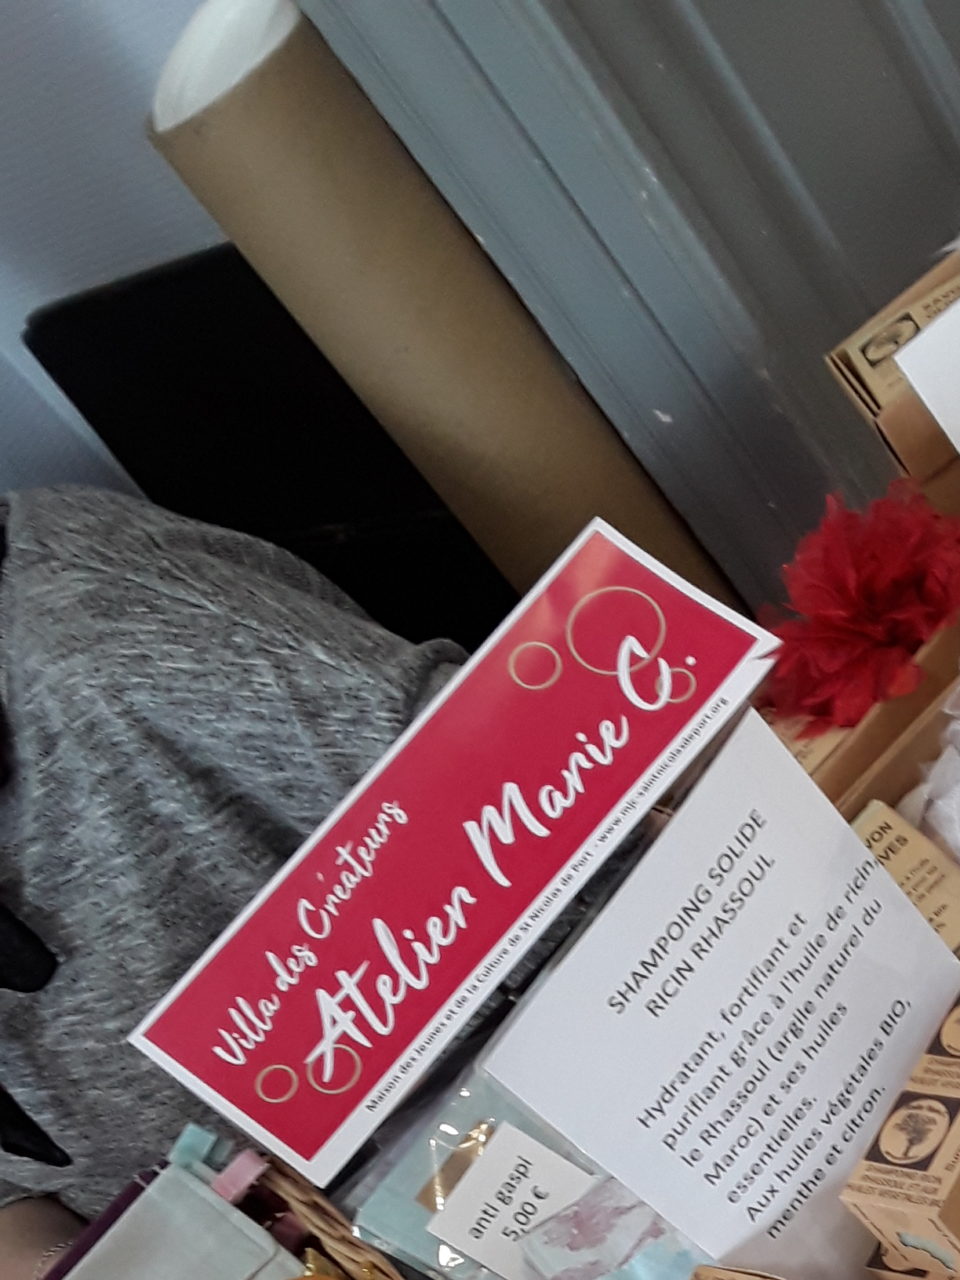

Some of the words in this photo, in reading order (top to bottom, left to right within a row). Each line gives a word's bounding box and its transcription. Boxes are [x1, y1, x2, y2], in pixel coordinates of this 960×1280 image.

[305, 886, 476, 1082] Atelier
[463, 716, 629, 887] Marie
[616, 634, 697, 712] C.
[864, 821, 894, 850] VON
[556, 869, 579, 891] de
[568, 847, 598, 877] Port
[843, 858, 879, 905] ricin,
[516, 918, 537, 938] St
[525, 883, 567, 927] Nicolas
[608, 884, 712, 1014] SHAMPOING
[708, 815, 764, 887] SOLIDE
[826, 905, 843, 932] de
[213, 996, 279, 1065] Villa
[265, 945, 318, 992] des
[298, 802, 408, 939] Créateurs
[503, 930, 527, 952] de
[645, 959, 695, 1017] RICIN
[690, 855, 775, 961] RHASSOUL
[473, 944, 515, 988] Culture
[779, 934, 825, 994] l'huile
[451, 991, 474, 1014] de
[463, 980, 484, 999] la
[775, 995, 786, 1010] à
[440, 1005, 463, 1026] et
[637, 1031, 726, 1129] Hydratant,
[720, 938, 789, 1025] fortifiant
[789, 913, 806, 937] et
[411, 1017, 452, 1061] Jeunes
[730, 1011, 771, 1068] grâce
[395, 1052, 422, 1079] des
[363, 1070, 406, 1116] Maison
[662, 1066, 731, 1151] purifiant
[747, 1184, 779, 1222] Aux
[774, 1131, 823, 1184] huiles
[820, 1041, 884, 1125] végétales
[879, 1000, 911, 1037] BIO,
[727, 1098, 817, 1204] essentielles.
[767, 1168, 824, 1239] menthe
[825, 1144, 843, 1166] et
[842, 1087, 886, 1143] citron.
[471, 1202, 500, 1240] anti
[496, 1155, 533, 1206] gaspi
[501, 1201, 538, 1242] 5,00
[533, 1183, 550, 1200] €
